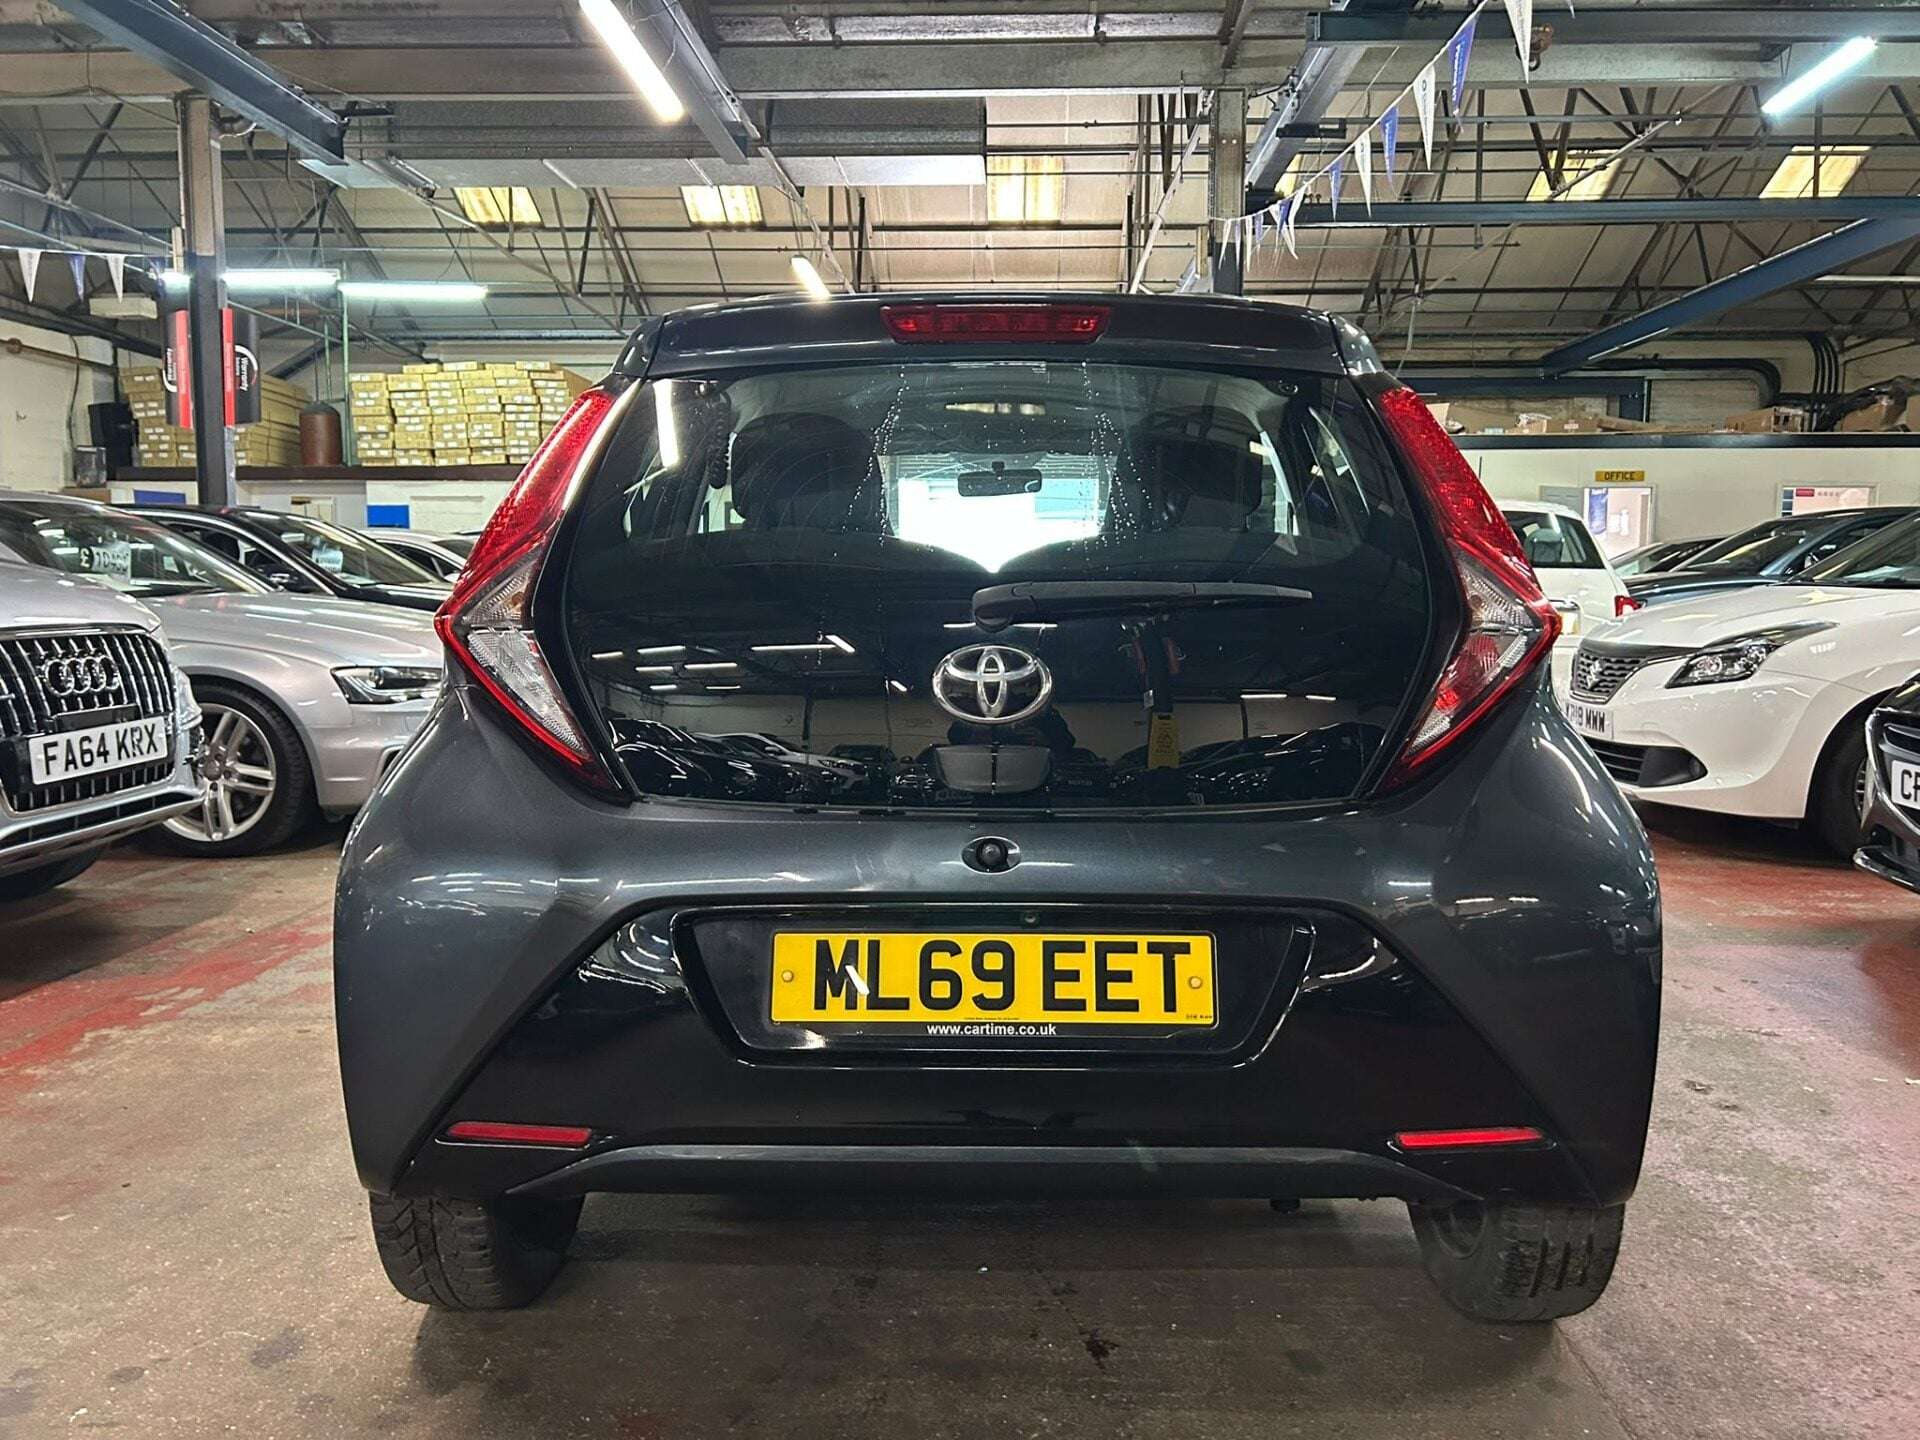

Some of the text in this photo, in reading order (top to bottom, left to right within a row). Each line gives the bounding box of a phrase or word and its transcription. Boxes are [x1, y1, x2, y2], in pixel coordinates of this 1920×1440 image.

[240, 357, 249, 391] Warranty
[1604, 471, 1636, 480] OFFICE
[43, 723, 158, 776] FA64 KRX
[813, 938, 1191, 1013] ML69 EET
[926, 1023, 1057, 1037] www.cartime.co.uk
